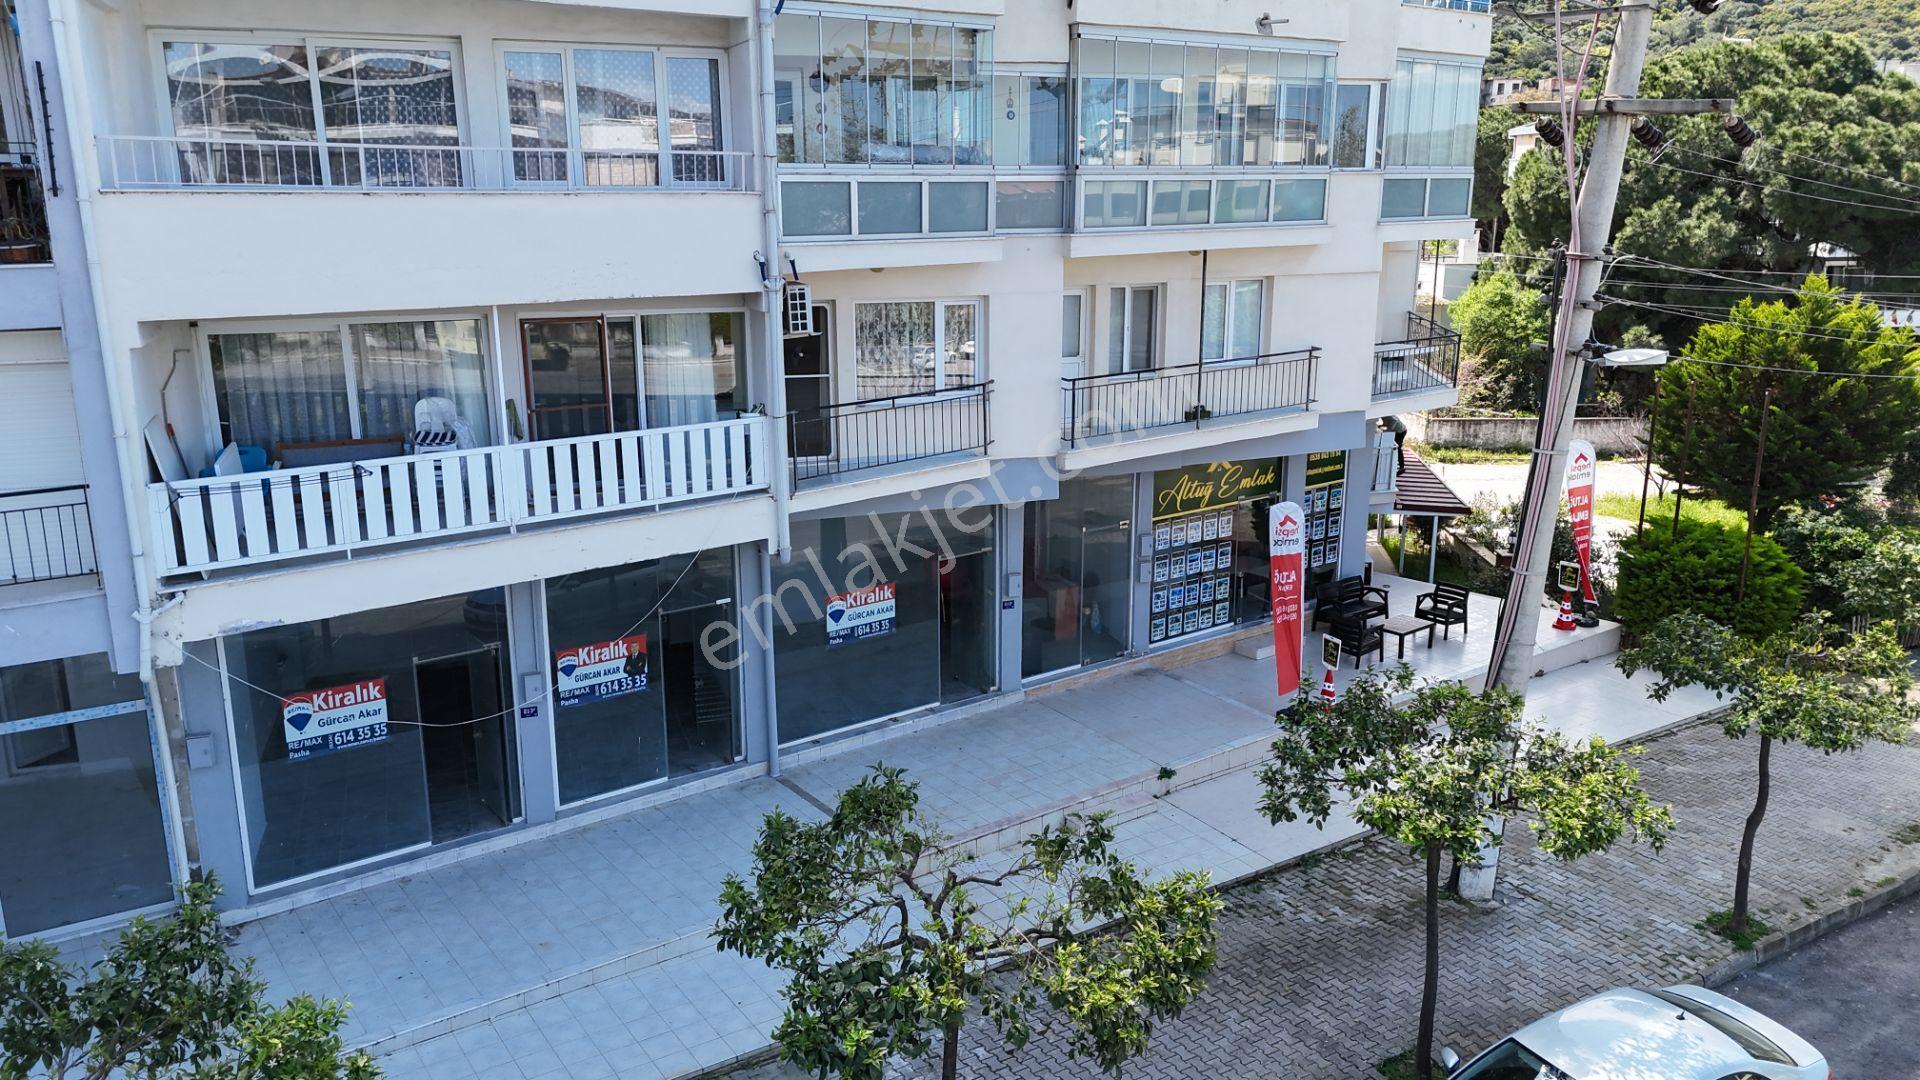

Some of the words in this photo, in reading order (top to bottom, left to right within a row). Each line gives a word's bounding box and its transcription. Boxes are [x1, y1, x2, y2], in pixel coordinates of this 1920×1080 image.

[1158, 474, 1213, 512] Altuğ
[1218, 465, 1276, 498] Emlak
[847, 586, 893, 608] Kiralık
[876, 604, 894, 615] AKAR
[858, 624, 870, 636] 614
[871, 621, 880, 632] 35
[881, 620, 890, 630] 35
[578, 641, 628, 666] Kiralık
[603, 666, 621, 677] AKAR
[312, 682, 382, 712] Kiralık
[560, 687, 590, 699] RE/MAX
[600, 682, 619, 695] 614
[620, 678, 633, 690] 35
[634, 674, 647, 687] 35
[317, 714, 356, 728] Gürcan
[358, 707, 382, 720] Akar
[288, 736, 323, 750] RE/MAX
[334, 730, 355, 745] 614
[357, 726, 371, 740] 35
[373, 723, 388, 737] 35
[289, 749, 310, 759] Pasha
